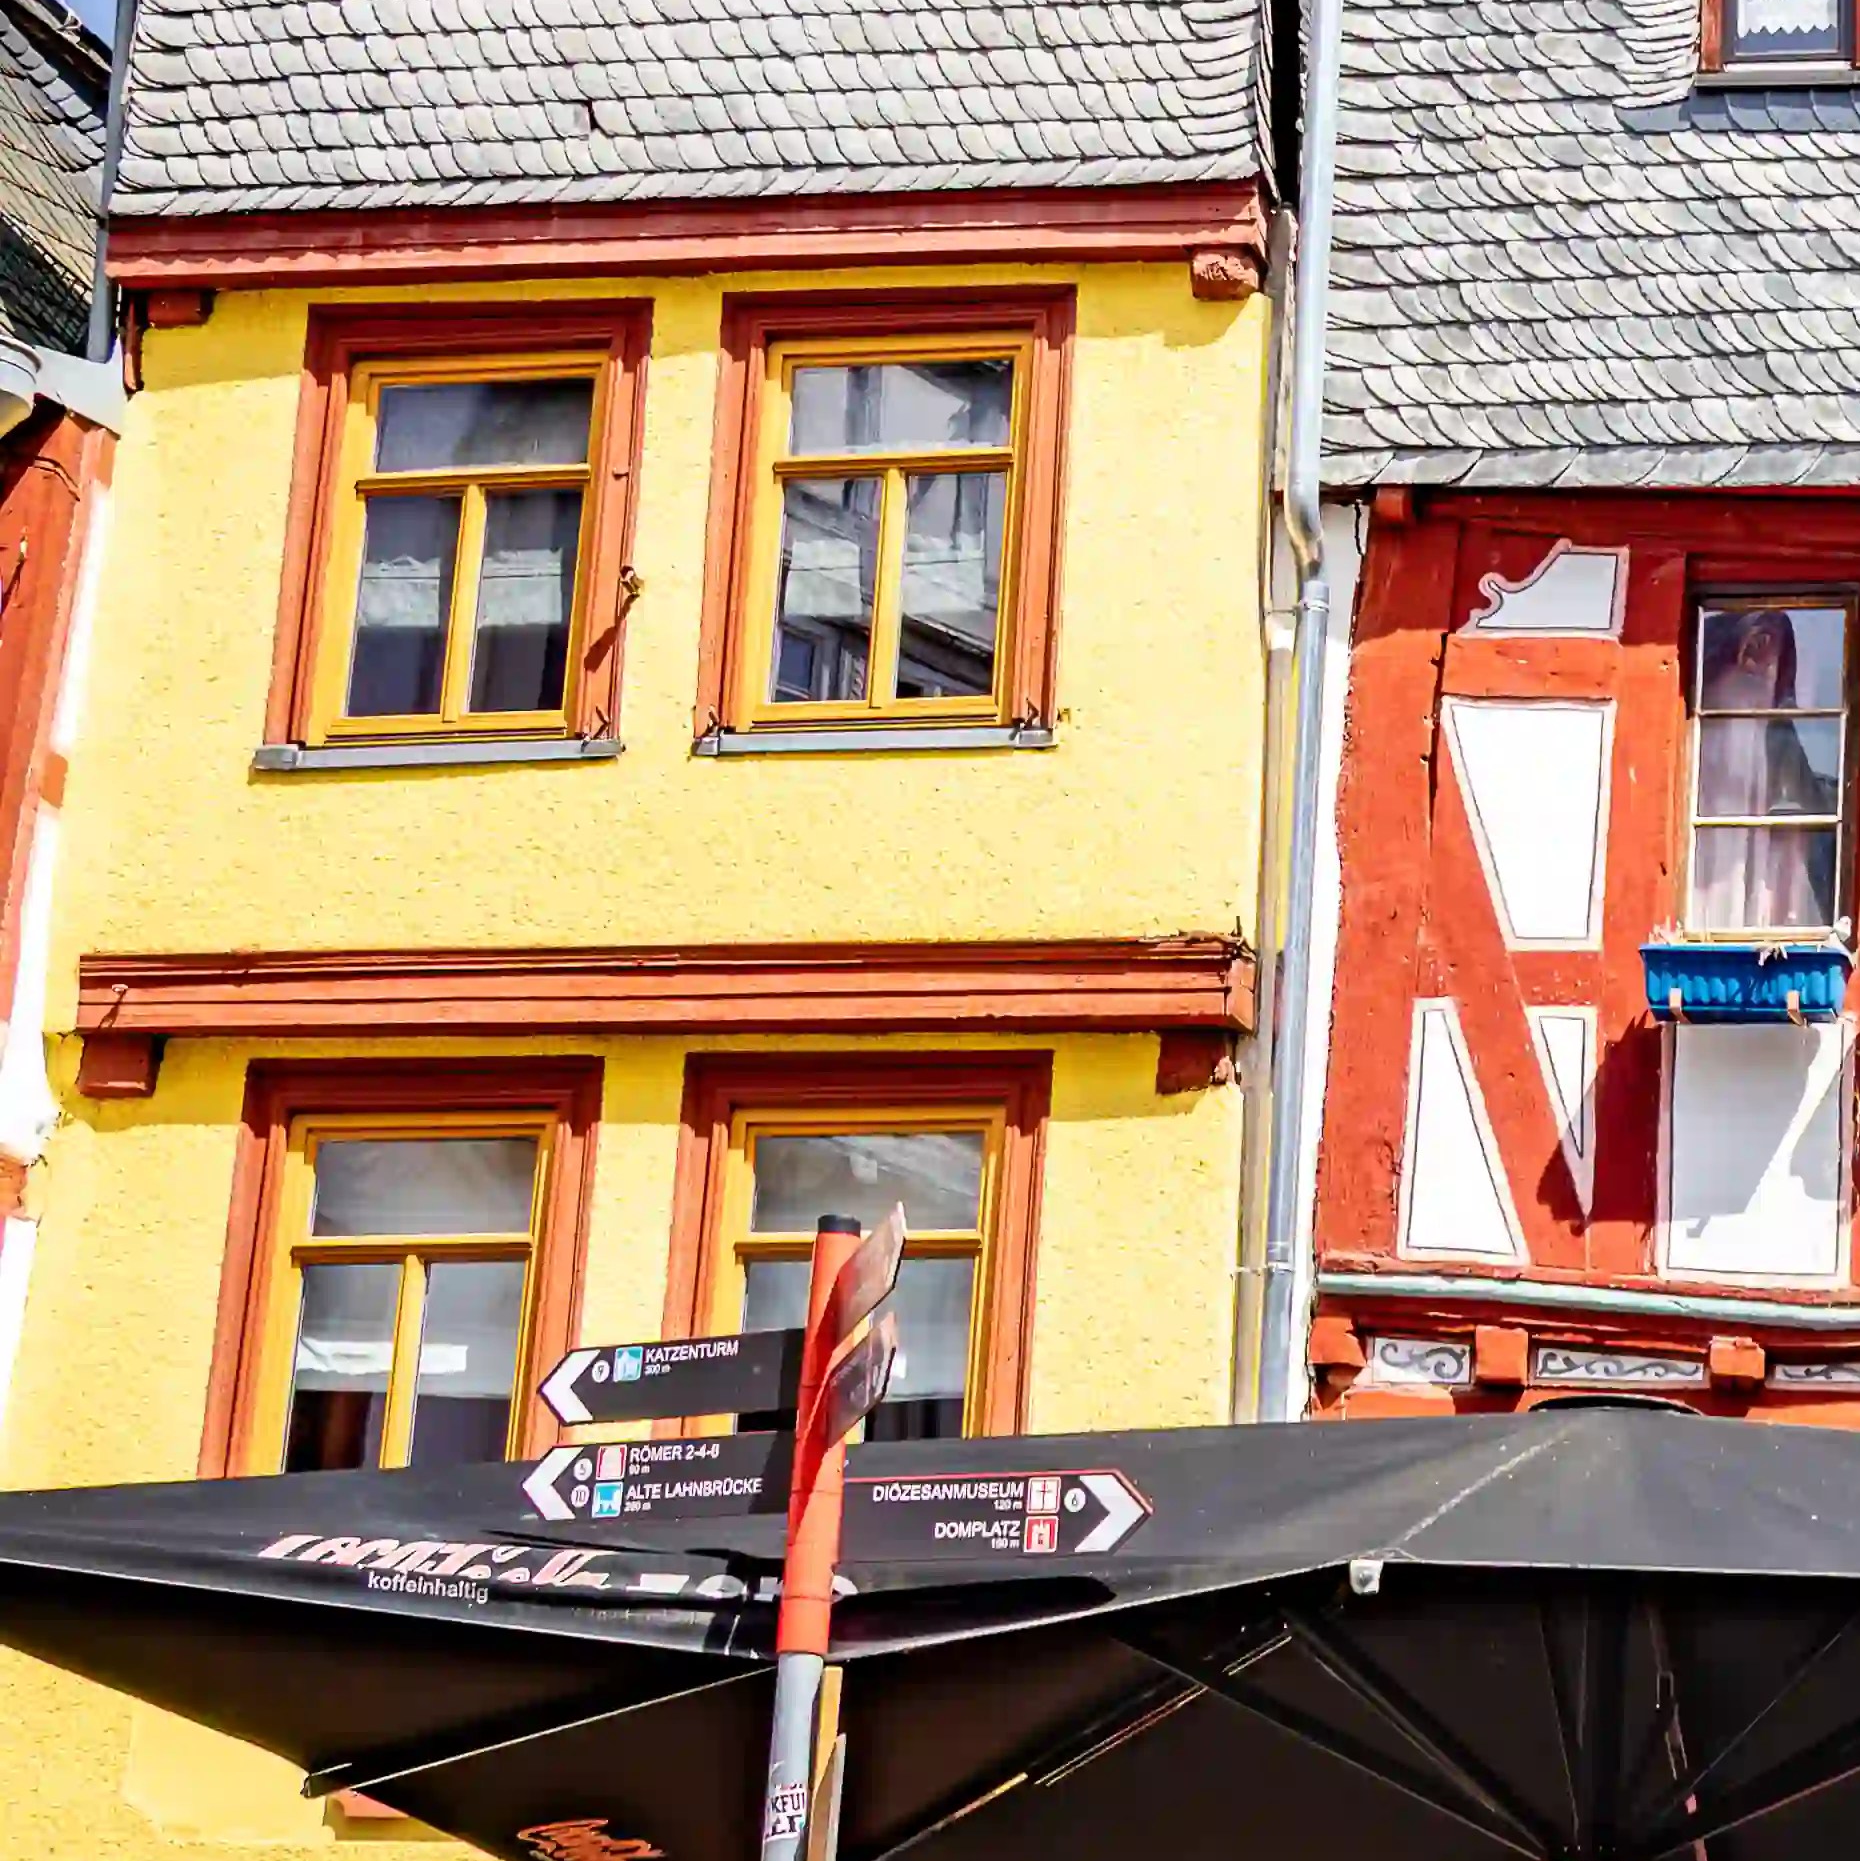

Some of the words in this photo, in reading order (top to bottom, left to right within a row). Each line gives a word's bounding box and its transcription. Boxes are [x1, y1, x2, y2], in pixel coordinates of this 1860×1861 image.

[645, 1340, 740, 1363] KATZENTURM
[629, 1443, 683, 1463] RÖMER
[626, 1483, 662, 1502] ALTE
[664, 1477, 763, 1500] LAHNBRÜCKE
[872, 1481, 1024, 1503] DIÖZESANMUSEUM
[934, 1519, 1021, 1539] DOMPLATZ
[367, 1570, 489, 1604] koffeinhaltig
